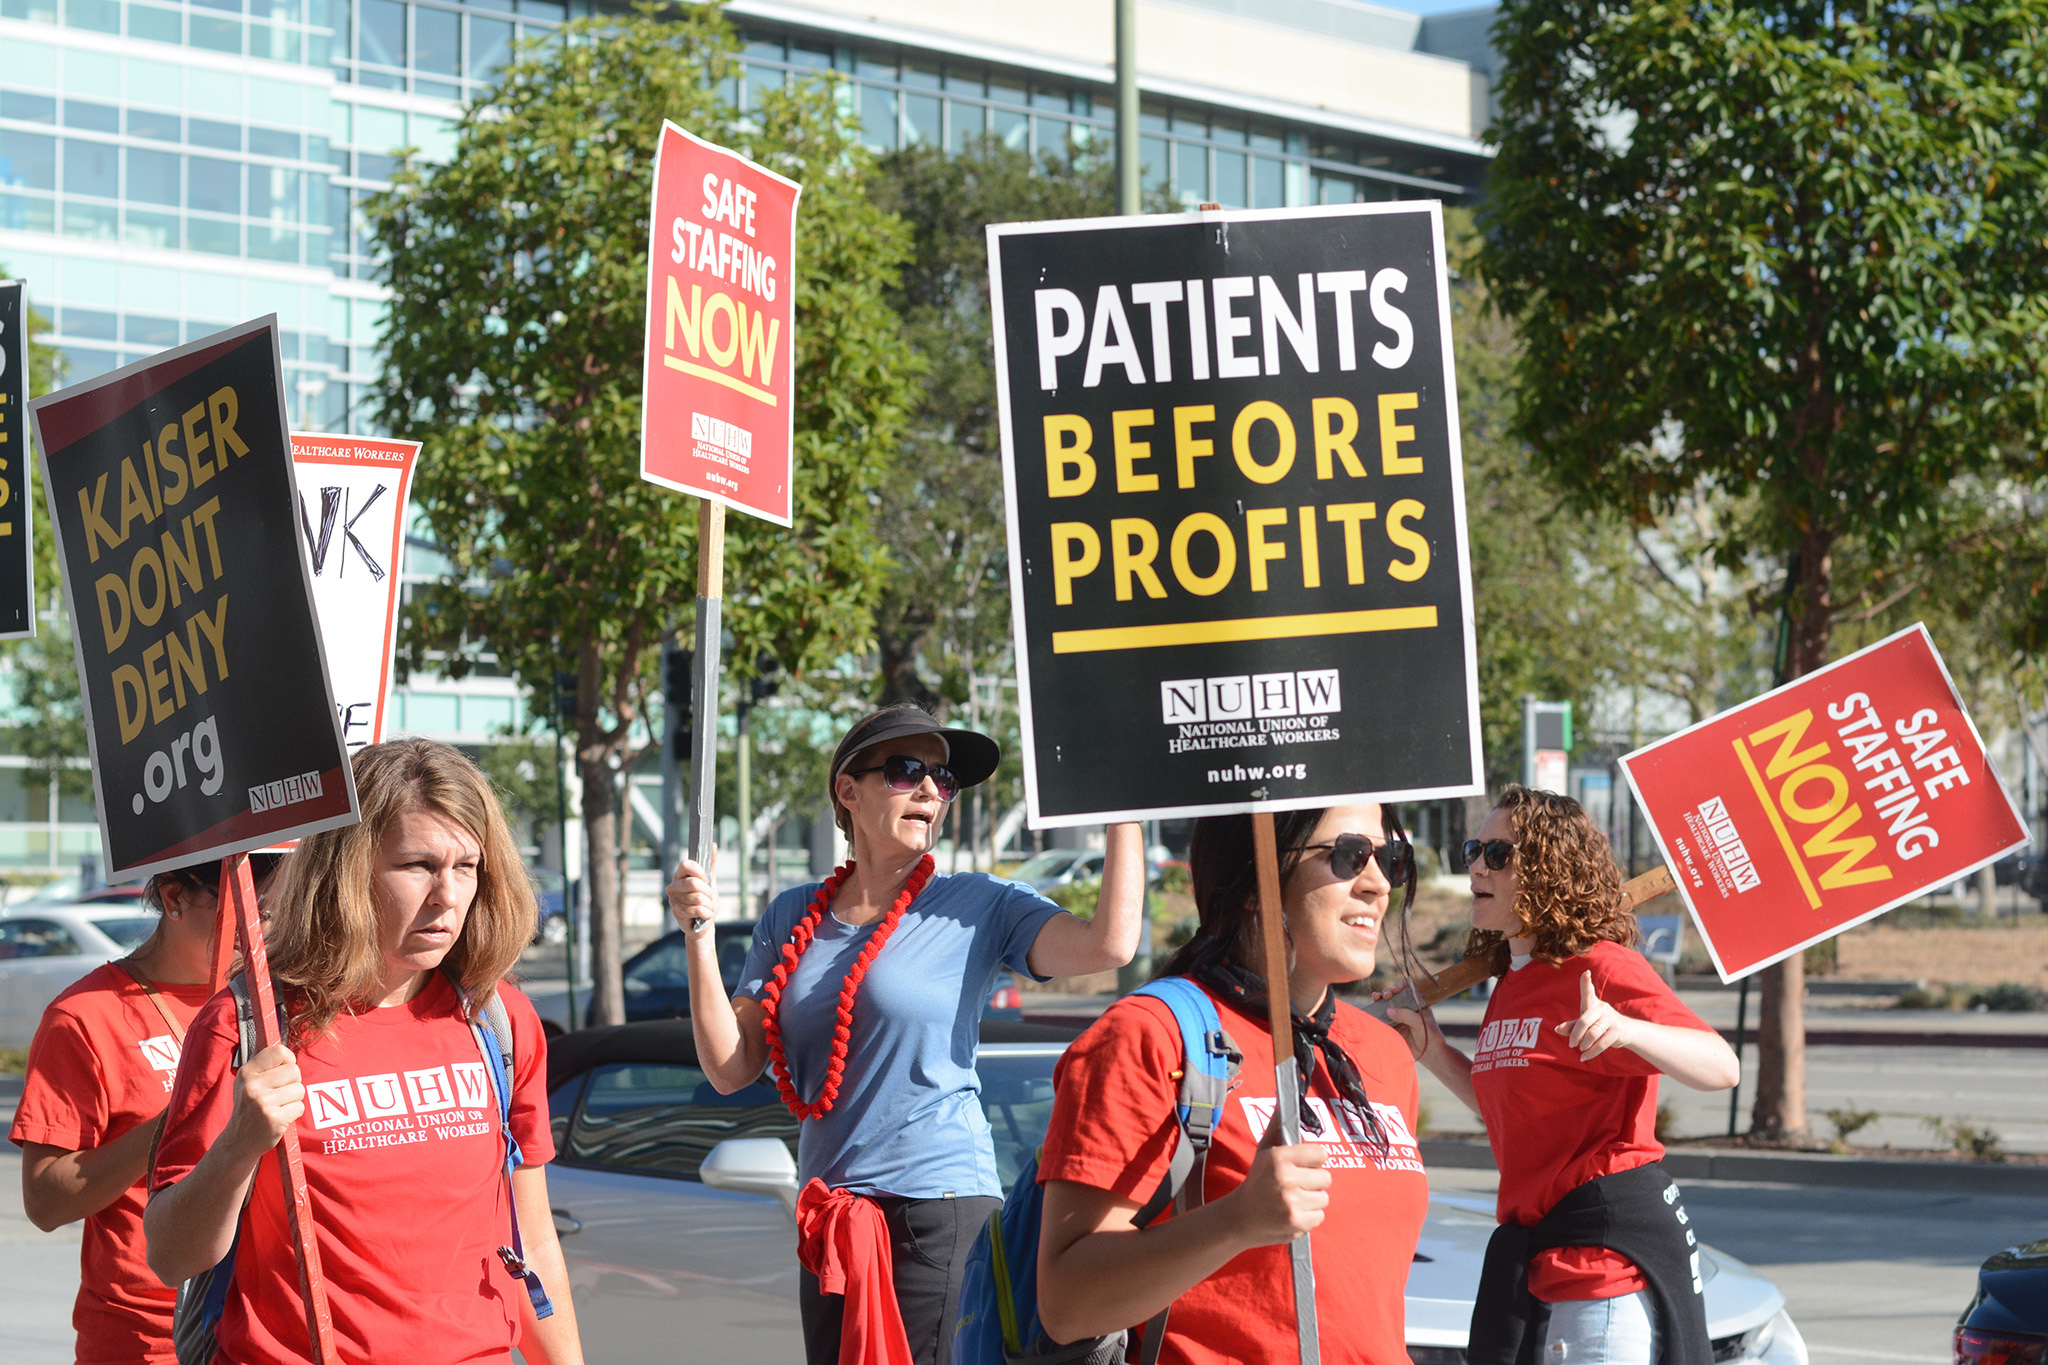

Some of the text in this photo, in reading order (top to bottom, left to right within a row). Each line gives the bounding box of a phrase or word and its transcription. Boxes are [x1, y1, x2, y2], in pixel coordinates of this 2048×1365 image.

[702, 173, 757, 238] SAFE
[671, 217, 776, 302] STAFFING
[665, 275, 780, 386] NOW
[1034, 268, 1414, 390] PATIENTS
[354, 447, 404, 461] WORKERS
[693, 414, 751, 455] NUHW
[1043, 392, 1424, 498] BEFORE
[78, 386, 250, 564] KAISER
[706, 472, 739, 492] nuhw.org
[95, 495, 223, 654] DONT
[1050, 499, 1431, 605] PROFITS
[111, 593, 229, 745] DENY
[1164, 673, 1338, 720] NUHW
[132, 715, 224, 815] .org
[1169, 729, 1340, 753] HEALTHCARE WORKERS
[1179, 715, 1329, 739] NATIONAL UNION OF
[1895, 708, 1970, 799] SAFE
[249, 773, 322, 812] NUHW
[1207, 763, 1307, 783] nuhw.org
[1748, 708, 1893, 890] NOW
[1828, 692, 1939, 860] STAFFING
[1675, 837, 1704, 888] nuhw.org
[1683, 812, 1730, 899] HEALTHCARE WORKERS
[1693, 814, 1735, 890] NATIONAL UNION OF
[1700, 799, 1759, 890] NUHW
[1512, 1048, 1524, 1057] OF
[310, 1066, 486, 1125] NUHW
[331, 1118, 414, 1139] NATIONAL
[417, 1111, 465, 1129] UNION
[323, 1122, 490, 1155] HEALTHCARE WORKERS
